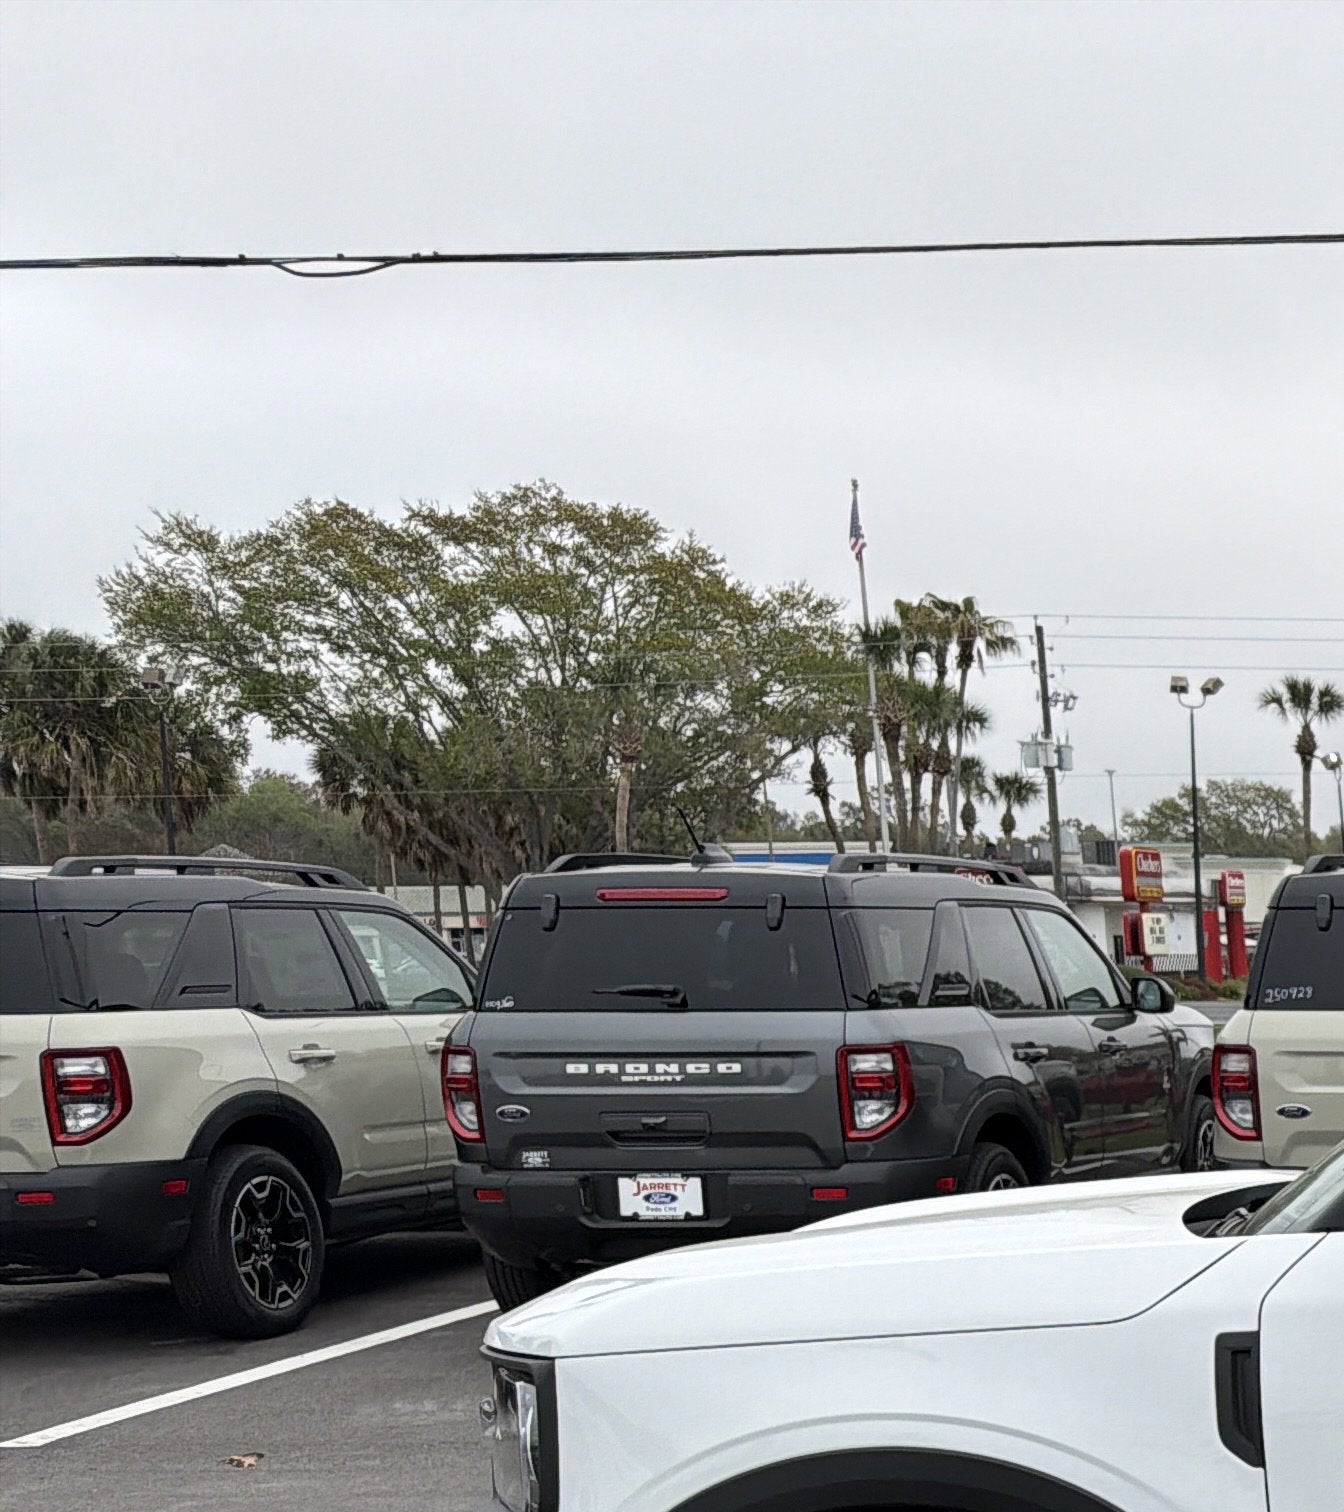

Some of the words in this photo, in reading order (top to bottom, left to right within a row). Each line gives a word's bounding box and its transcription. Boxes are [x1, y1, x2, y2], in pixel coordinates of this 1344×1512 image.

[1264, 985, 1313, 1003] 250928
[565, 1063, 742, 1074] BRONCO
[632, 1181, 687, 1196] JARRETT
